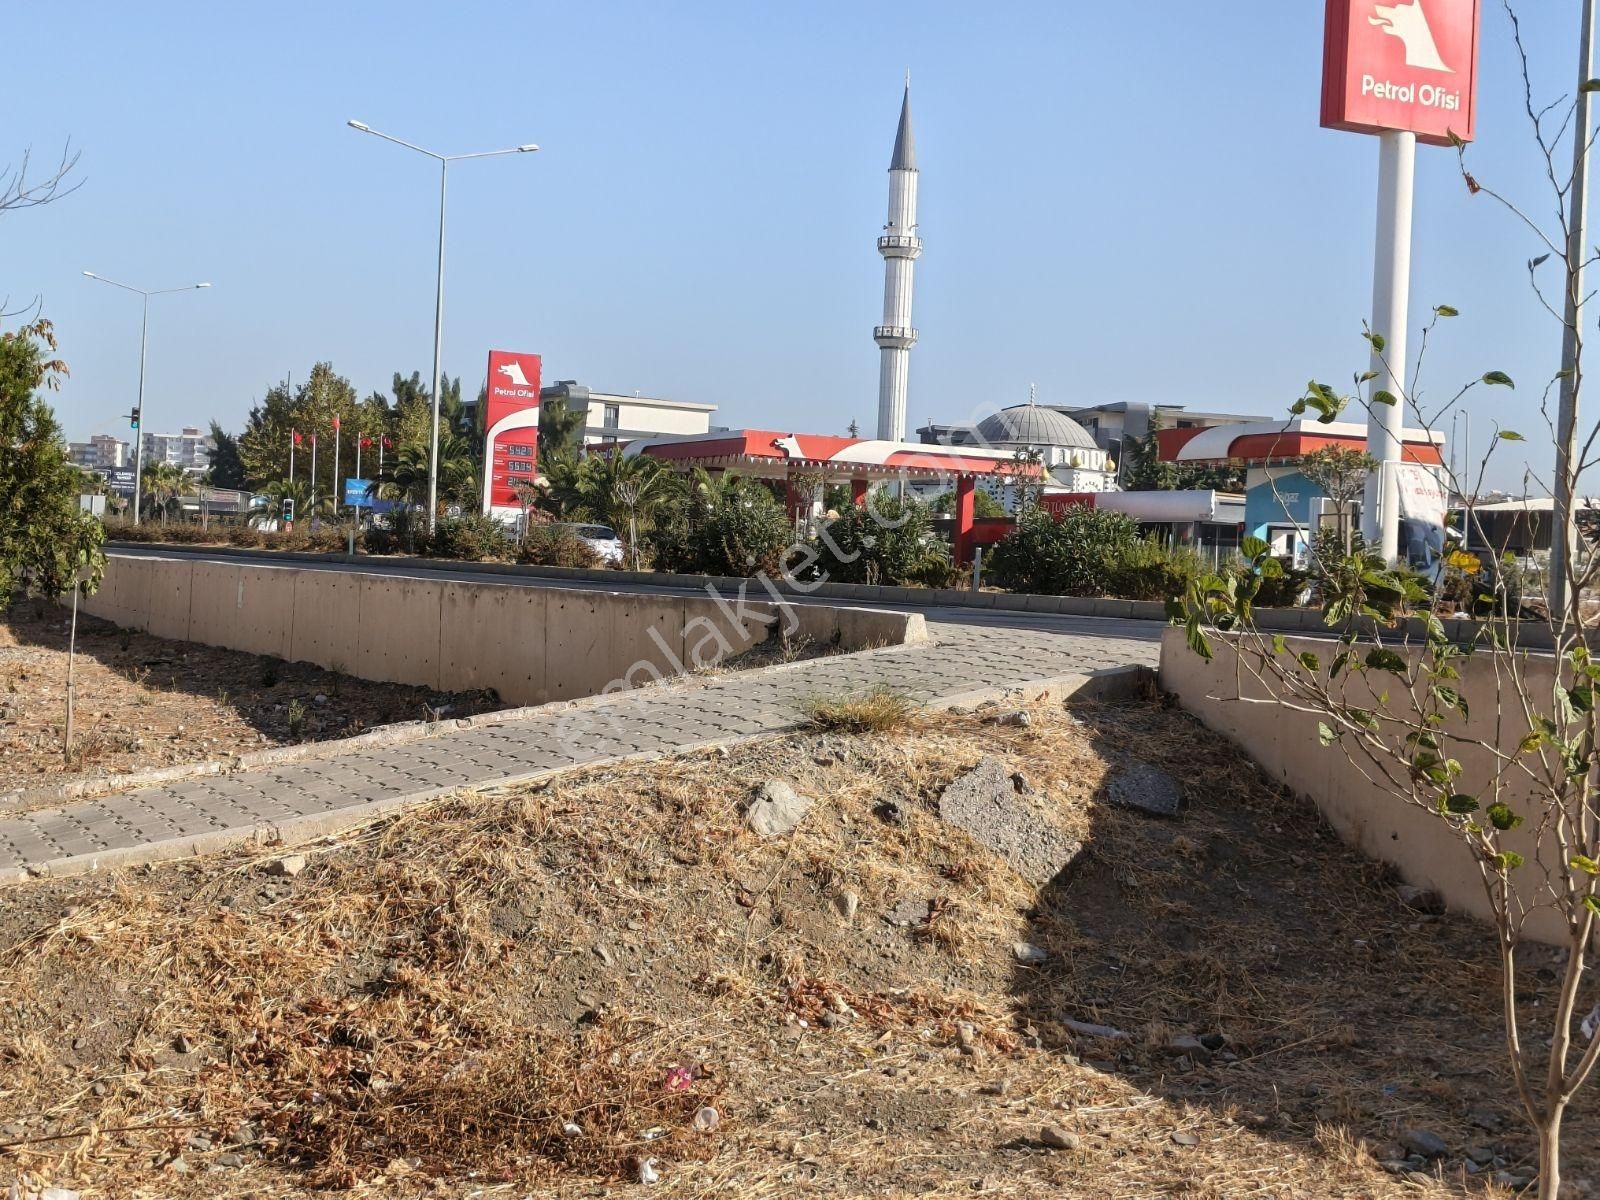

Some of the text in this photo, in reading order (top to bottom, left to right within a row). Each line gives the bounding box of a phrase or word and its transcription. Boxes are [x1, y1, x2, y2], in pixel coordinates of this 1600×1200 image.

[1361, 74, 1461, 111] Petrol Ofisi
[494, 387, 534, 398] Petrol Ofisi
